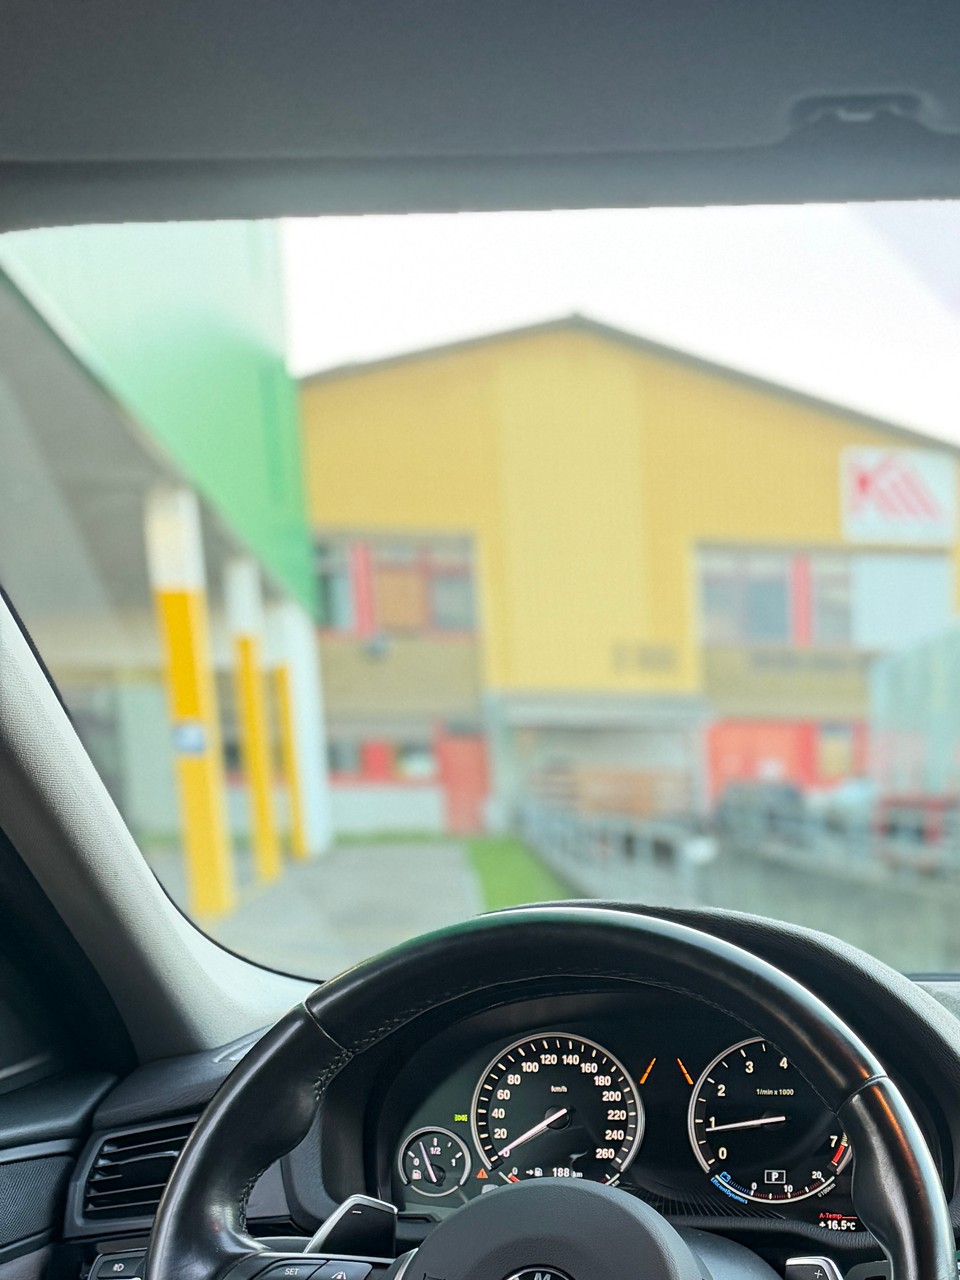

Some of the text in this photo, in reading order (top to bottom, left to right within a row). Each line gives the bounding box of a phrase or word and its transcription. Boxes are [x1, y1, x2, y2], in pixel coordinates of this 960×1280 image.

[540, 1054, 557, 1065] 120
[561, 1054, 580, 1065] 140
[779, 1056, 788, 1069] 4
[521, 1062, 539, 1073] 100
[580, 1063, 598, 1073] 160
[745, 1061, 754, 1073] 3
[507, 1074, 521, 1085] 80
[593, 1076, 611, 1086] 180
[496, 1089, 510, 1100] 60
[550, 1085, 568, 1093] km/h
[717, 1084, 726, 1097] 2
[602, 1091, 621, 1102] 200
[491, 1108, 505, 1119] 40
[607, 1110, 627, 1120] 220
[709, 1116, 716, 1128] 1
[494, 1128, 507, 1139] 20
[605, 1130, 624, 1141] 240
[830, 1135, 838, 1147] 7
[430, 1147, 441, 1155] 1/2
[595, 1148, 615, 1159] 260
[718, 1147, 727, 1159] 0
[552, 1167, 570, 1177] 188
[772, 1172, 779, 1182] P
[811, 1171, 822, 1179] 20
[751, 1182, 757, 1190] 0
[783, 1184, 793, 1193] 10
[284, 1268, 299, 1276] SET
